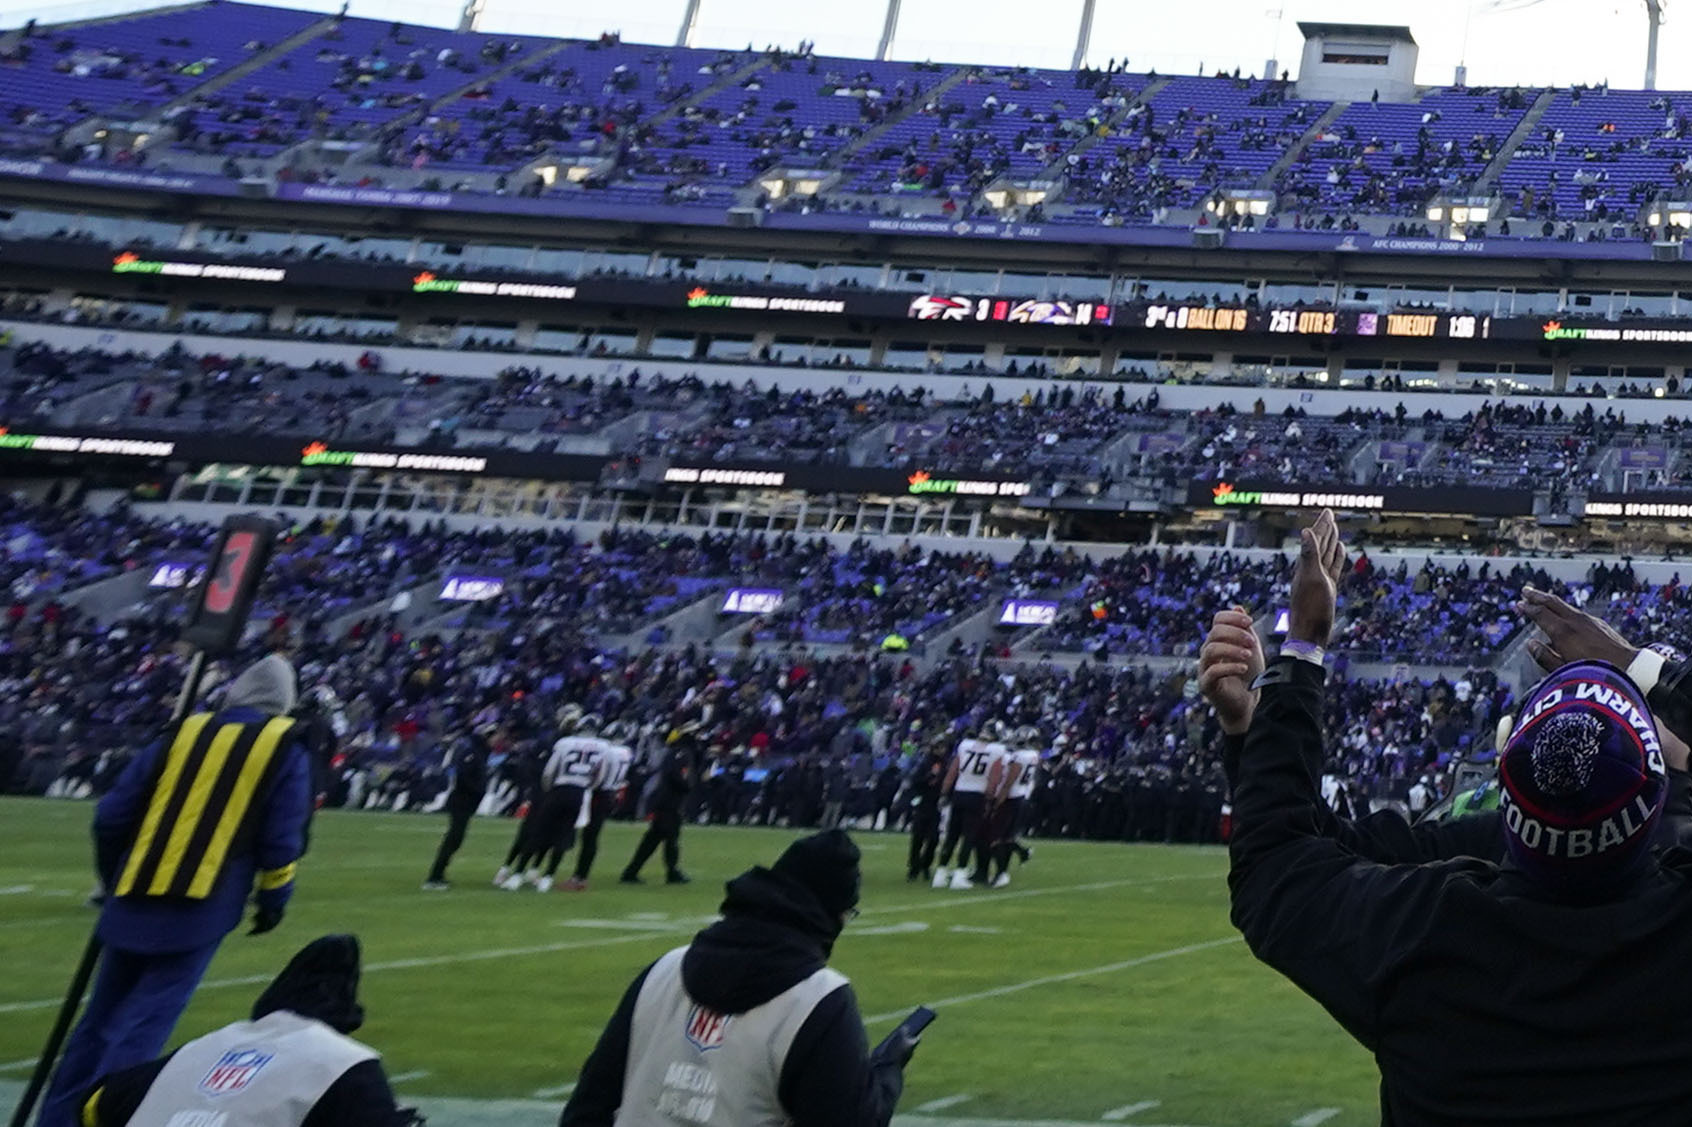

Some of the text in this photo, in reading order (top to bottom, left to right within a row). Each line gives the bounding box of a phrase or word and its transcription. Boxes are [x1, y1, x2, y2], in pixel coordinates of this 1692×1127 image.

[1372, 239, 1389, 250] AFC
[1389, 240, 1437, 250] CHAMPIONS
[1463, 242, 1485, 252] 2012
[688, 295, 846, 313] DRAFTKINGS SPORTSBOOK
[1188, 308, 1215, 330] BALL
[1215, 309, 1232, 330] ON
[1299, 312, 1324, 334] QTR
[1324, 313, 1336, 334] 3
[1387, 315, 1438, 336] TIMEOUT
[1544, 326, 1621, 340] DRAFTKINGS
[909, 478, 999, 495] DRAFTKINGS
[1214, 489, 1384, 508] DRAFTKINGS SPORTSBOOK
[206, 533, 254, 612] 3
[1575, 682, 1666, 776] CHARM
[1500, 786, 1657, 858] FOOTBALL
[203, 1065, 252, 1090] NFL
